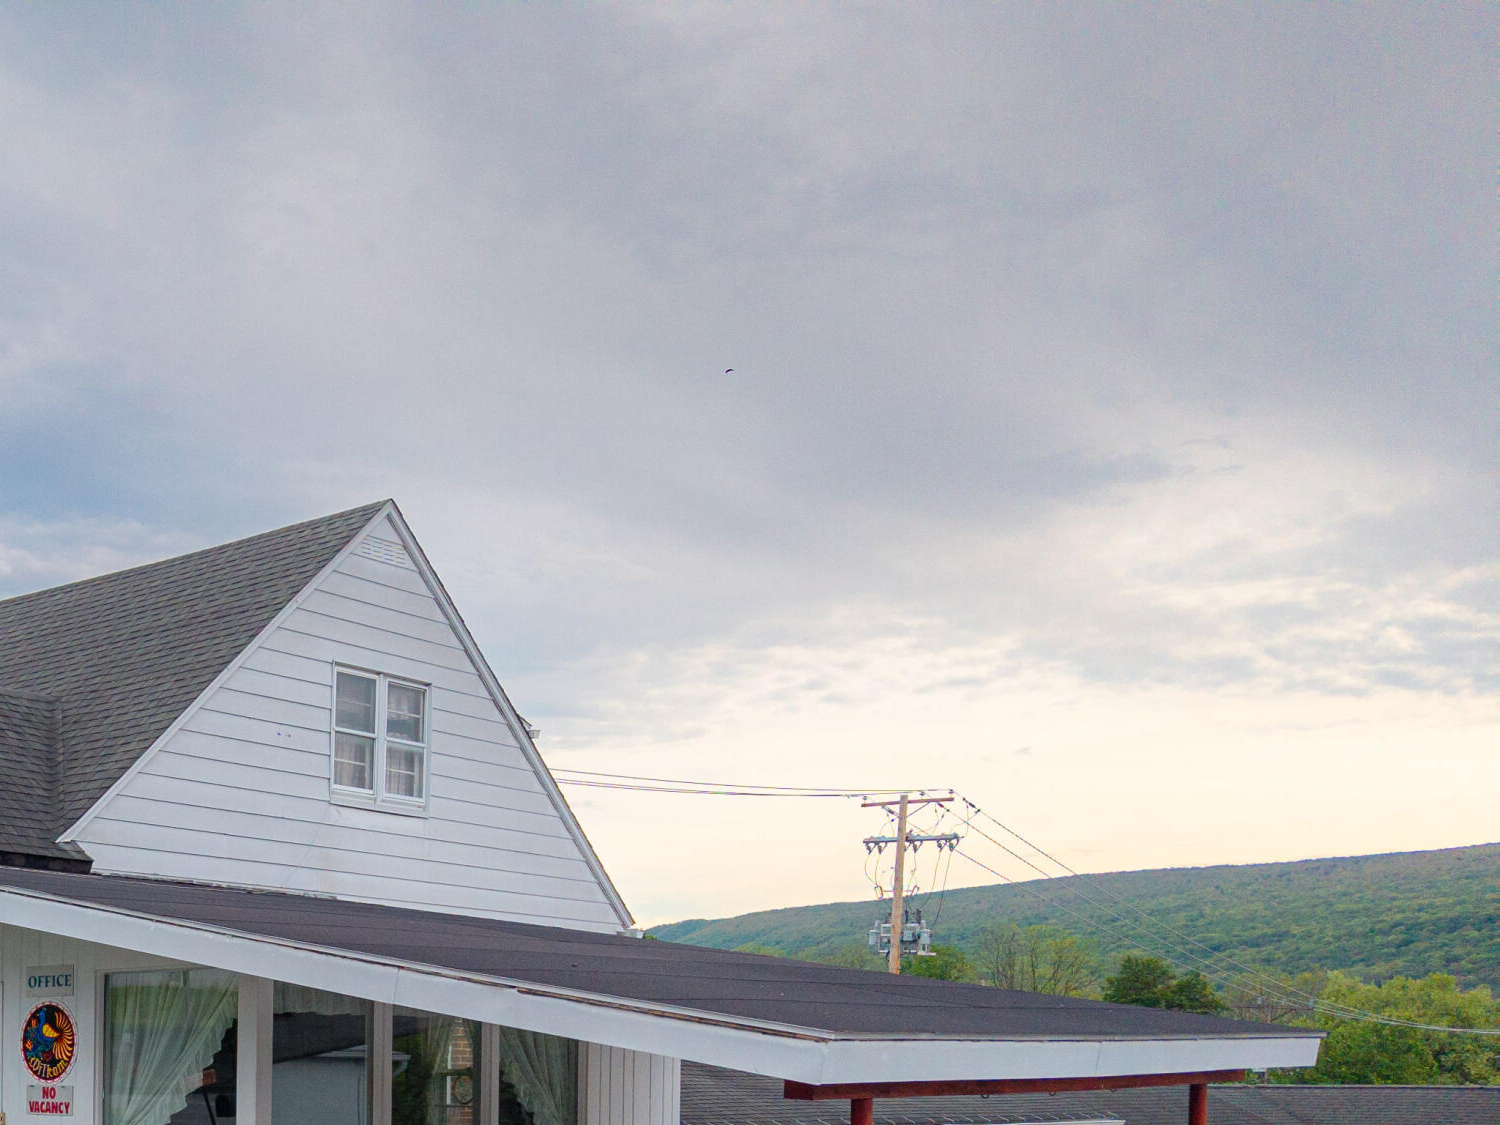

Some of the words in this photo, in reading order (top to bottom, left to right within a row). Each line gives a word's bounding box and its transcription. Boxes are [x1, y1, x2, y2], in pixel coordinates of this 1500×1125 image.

[28, 974, 72, 988] OFFICE
[42, 1086, 56, 1099] NO
[28, 1101, 70, 1114] VACANCY
